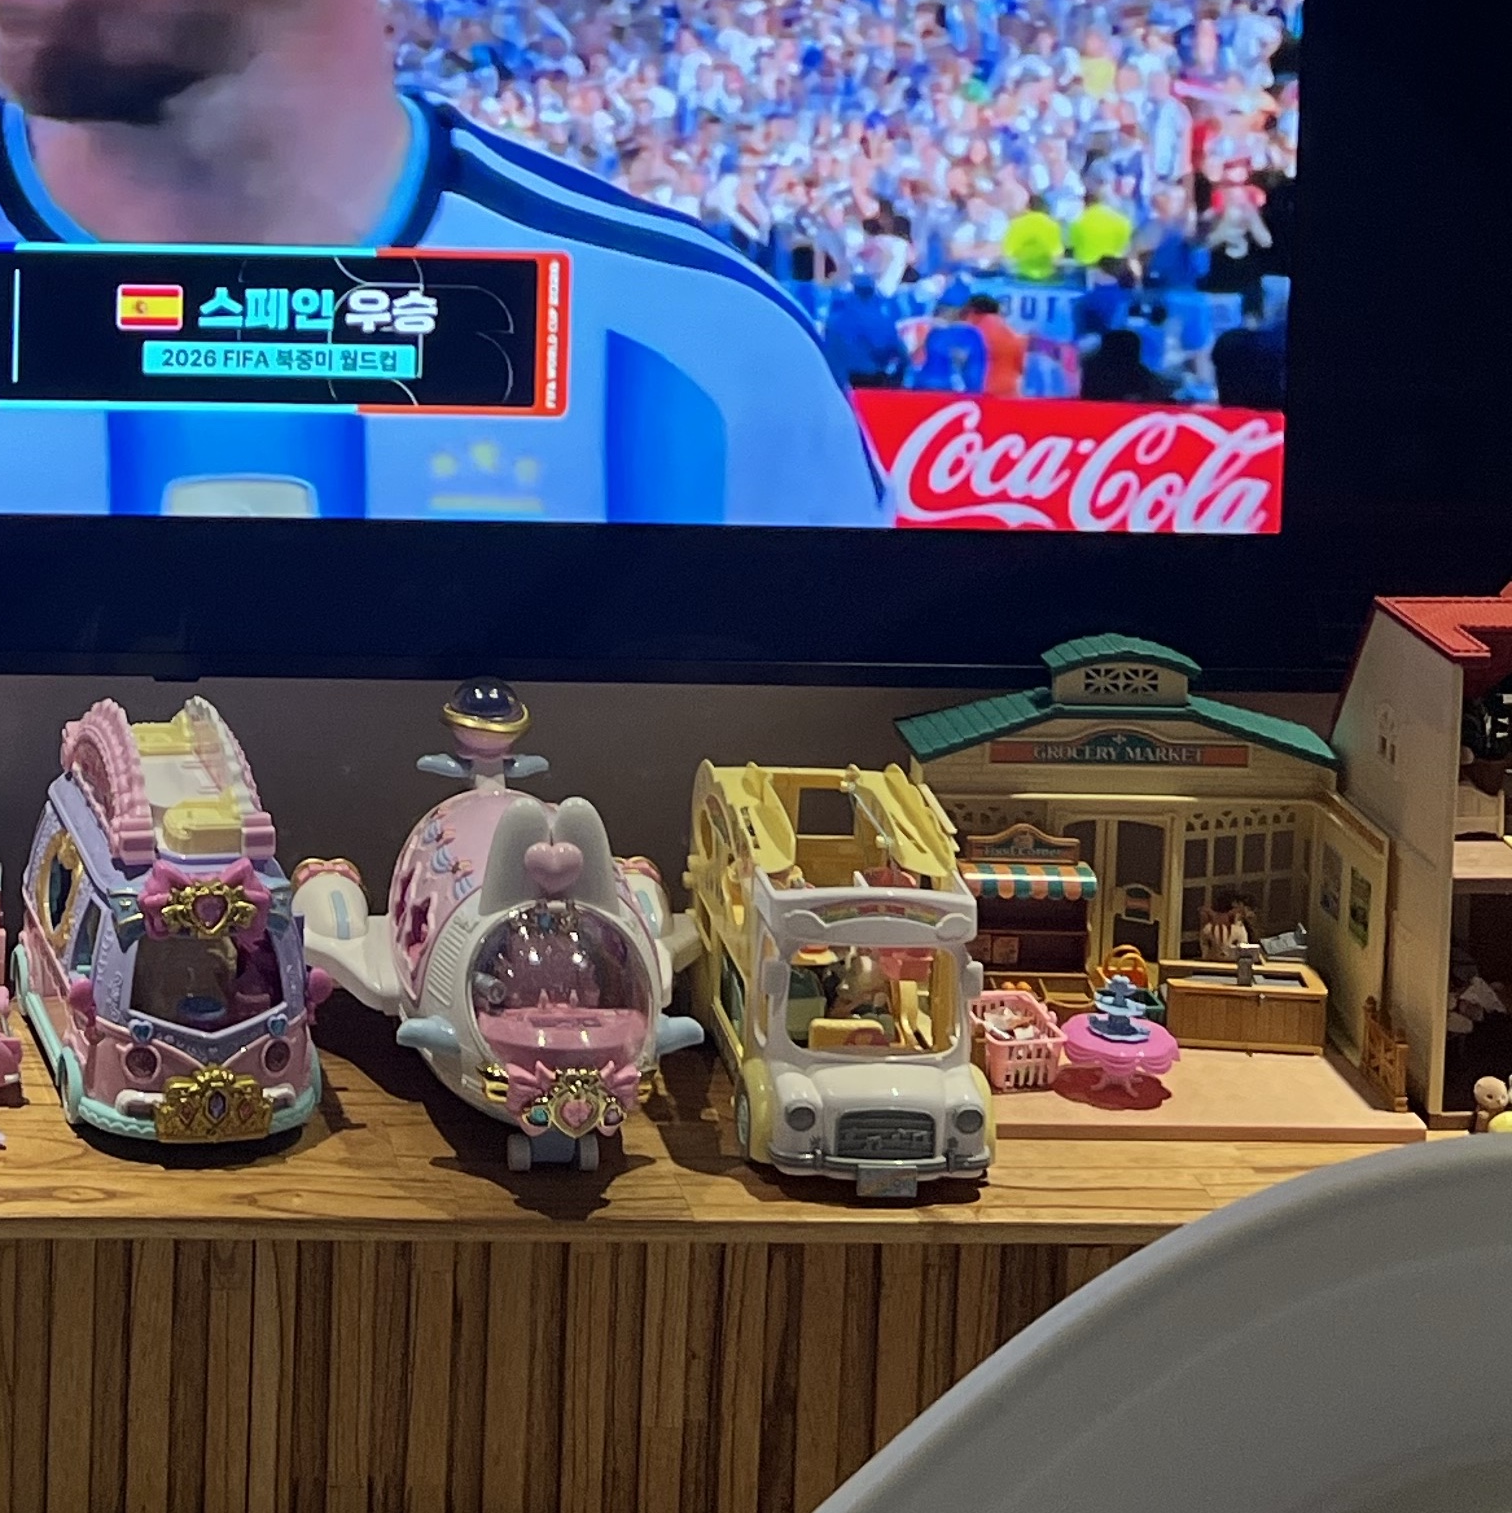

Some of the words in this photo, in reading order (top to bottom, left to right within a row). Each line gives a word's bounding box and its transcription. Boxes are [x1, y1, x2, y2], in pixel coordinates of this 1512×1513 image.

[198, 287, 335, 330] 스페인
[345, 289, 438, 334] 우승
[161, 349, 217, 367] 2026
[223, 350, 270, 368] FIFA
[276, 349, 333, 371] 북중미
[341, 350, 398, 372] 월드컵
[1033, 745, 1120, 761] GROCERY
[1125, 746, 1203, 763] MARKET
